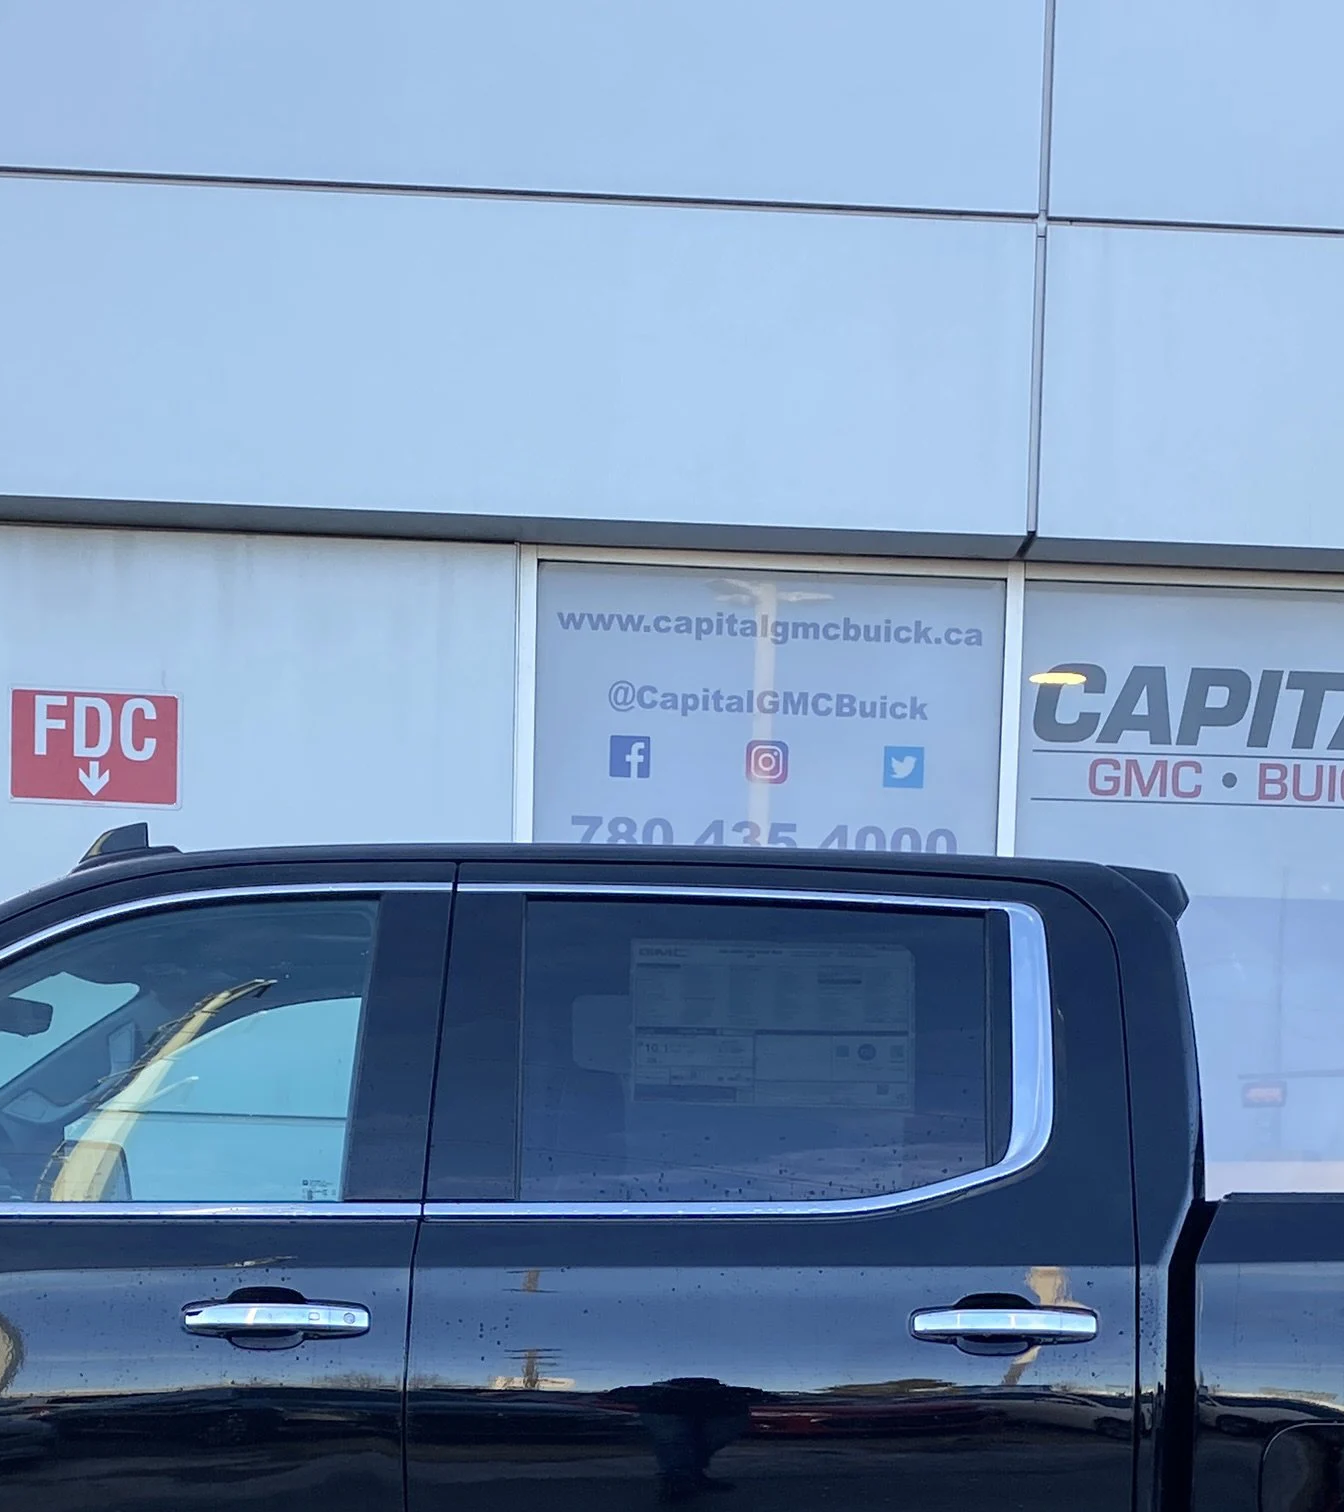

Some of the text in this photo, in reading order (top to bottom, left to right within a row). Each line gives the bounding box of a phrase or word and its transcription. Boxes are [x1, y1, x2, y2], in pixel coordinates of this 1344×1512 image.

[556, 610, 984, 647] www.capitalgmcbuick.ca
[607, 680, 929, 720] @CapitalGMCBuick
[33, 694, 157, 762] FDC
[1088, 758, 1203, 799] GMC
